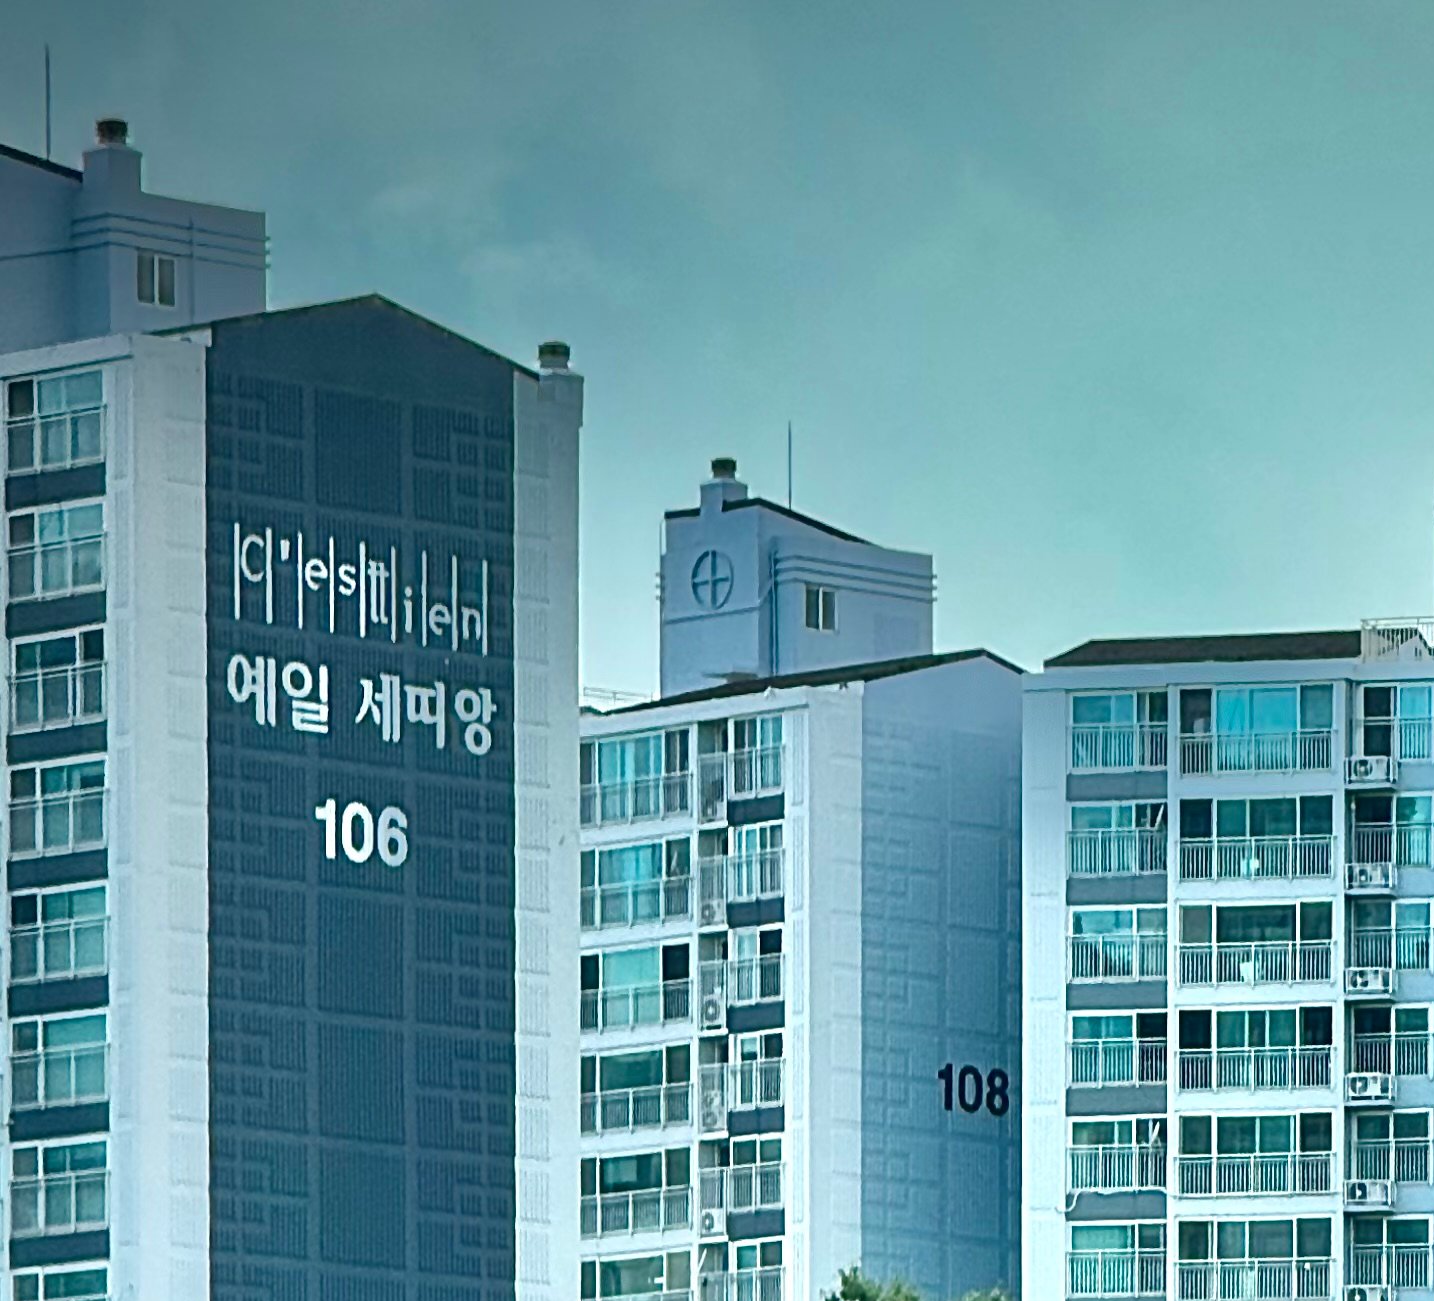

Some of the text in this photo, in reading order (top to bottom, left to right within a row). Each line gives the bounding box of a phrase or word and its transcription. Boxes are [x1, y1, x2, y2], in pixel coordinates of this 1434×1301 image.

[227, 653, 329, 734] 예일
[315, 797, 409, 867] 106
[938, 1063, 1009, 1117] 108
